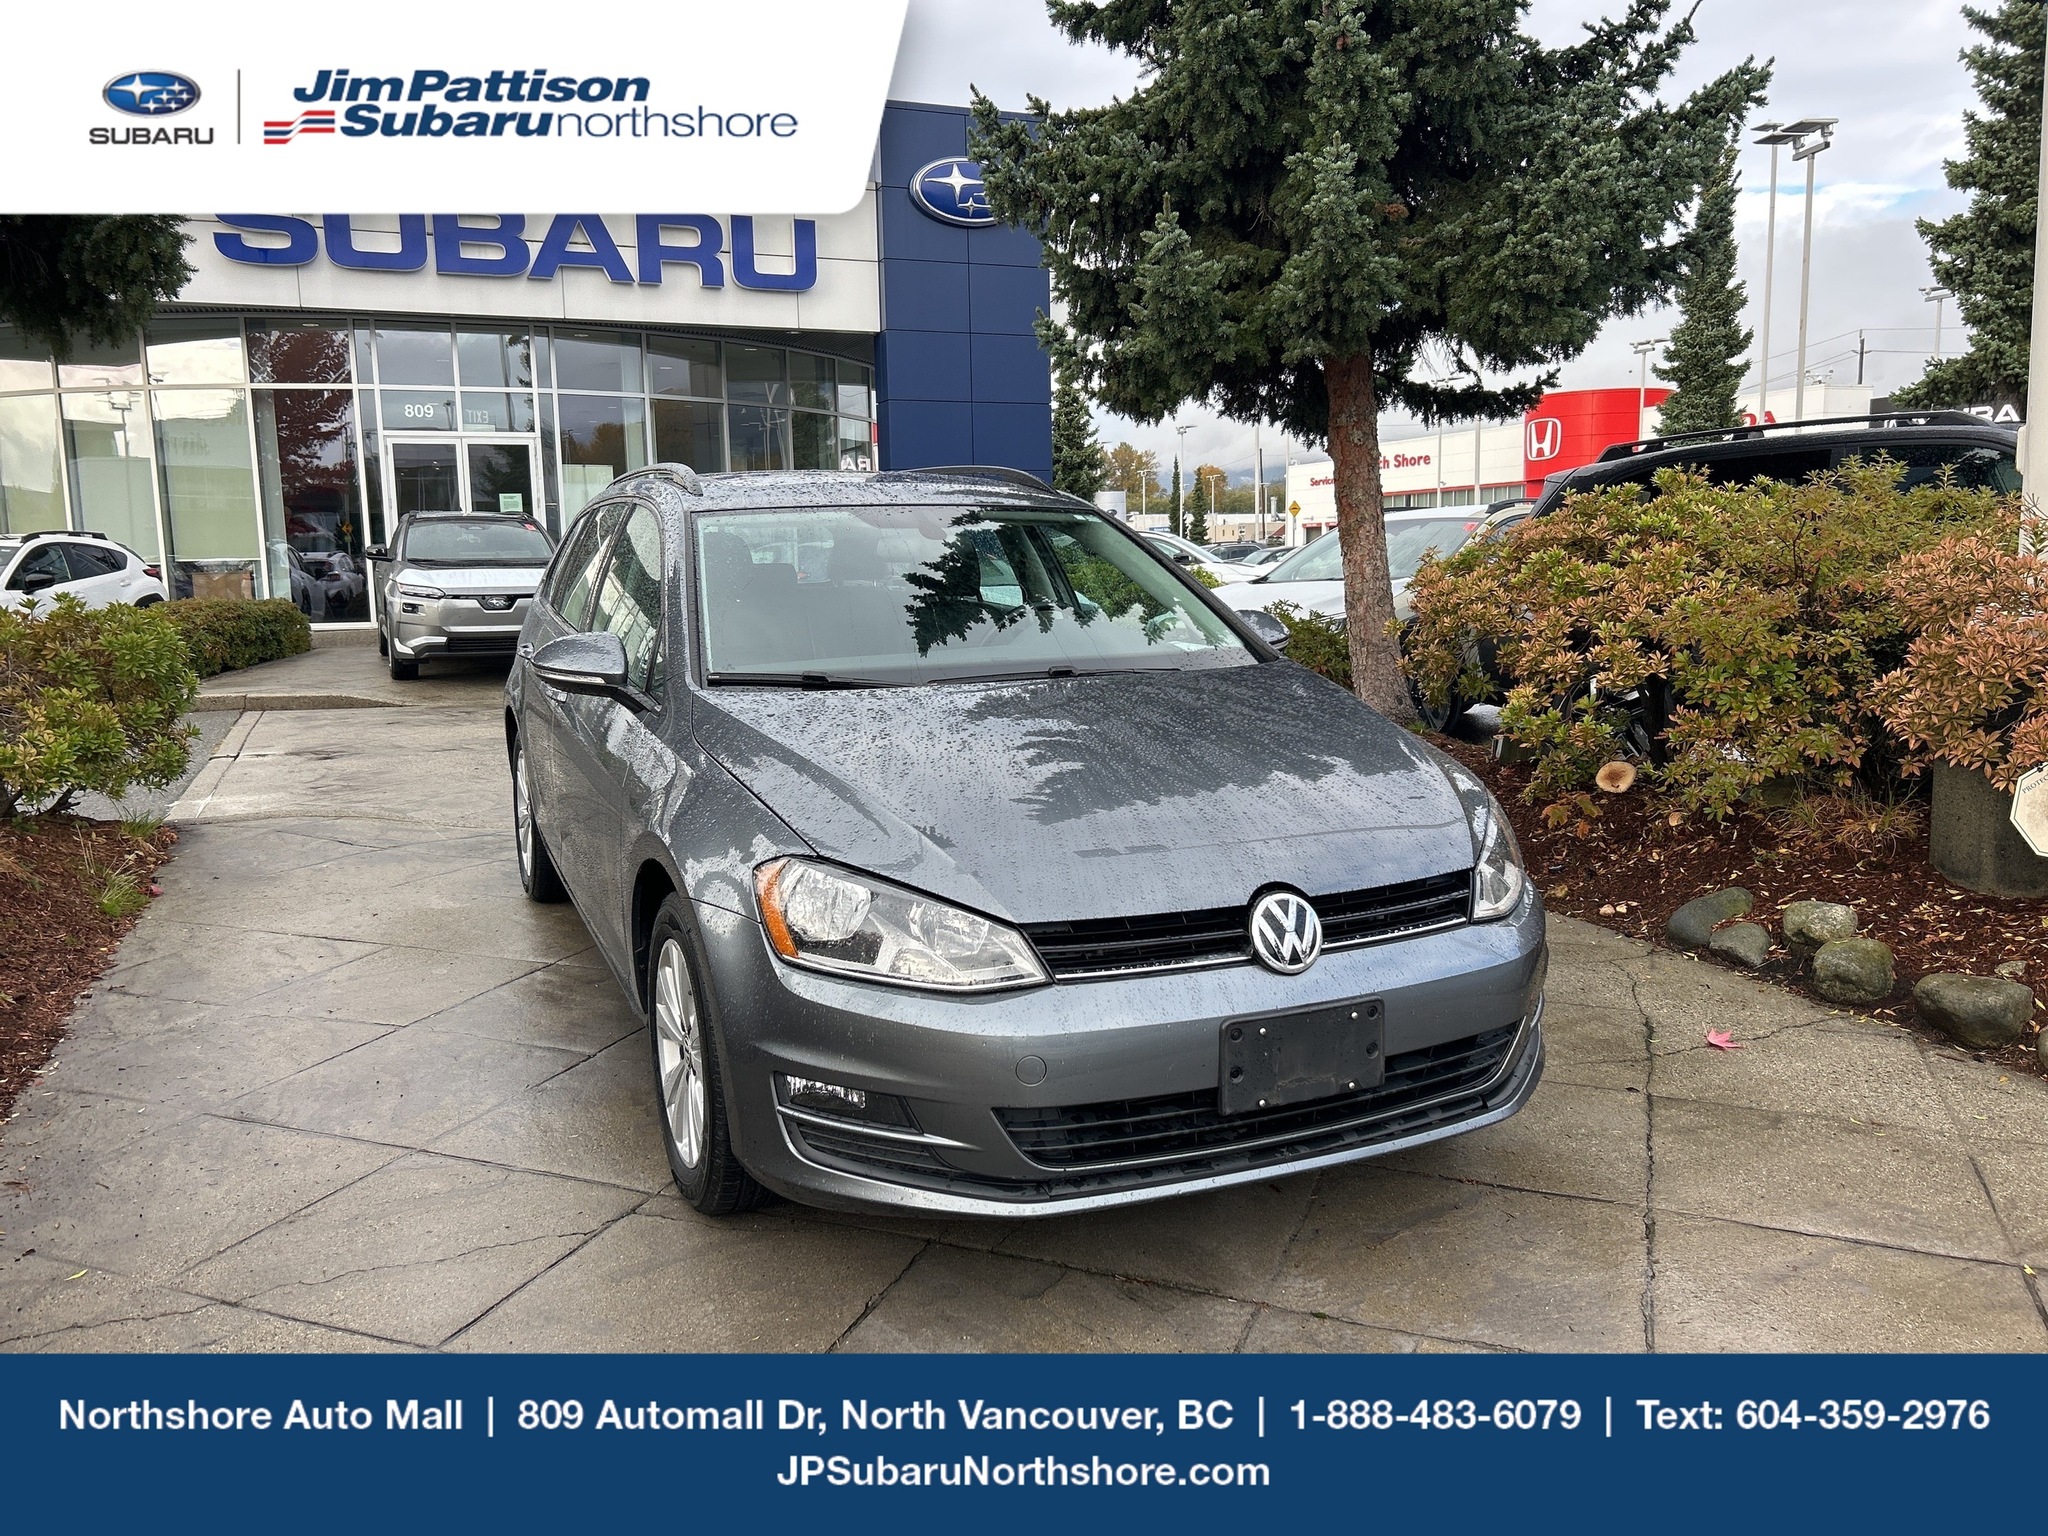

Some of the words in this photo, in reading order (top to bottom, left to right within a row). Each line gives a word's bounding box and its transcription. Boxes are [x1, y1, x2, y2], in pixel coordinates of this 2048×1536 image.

[213, 213, 818, 291] SUBARU
[404, 404, 434, 418] 809
[1393, 453, 1432, 468] Shore
